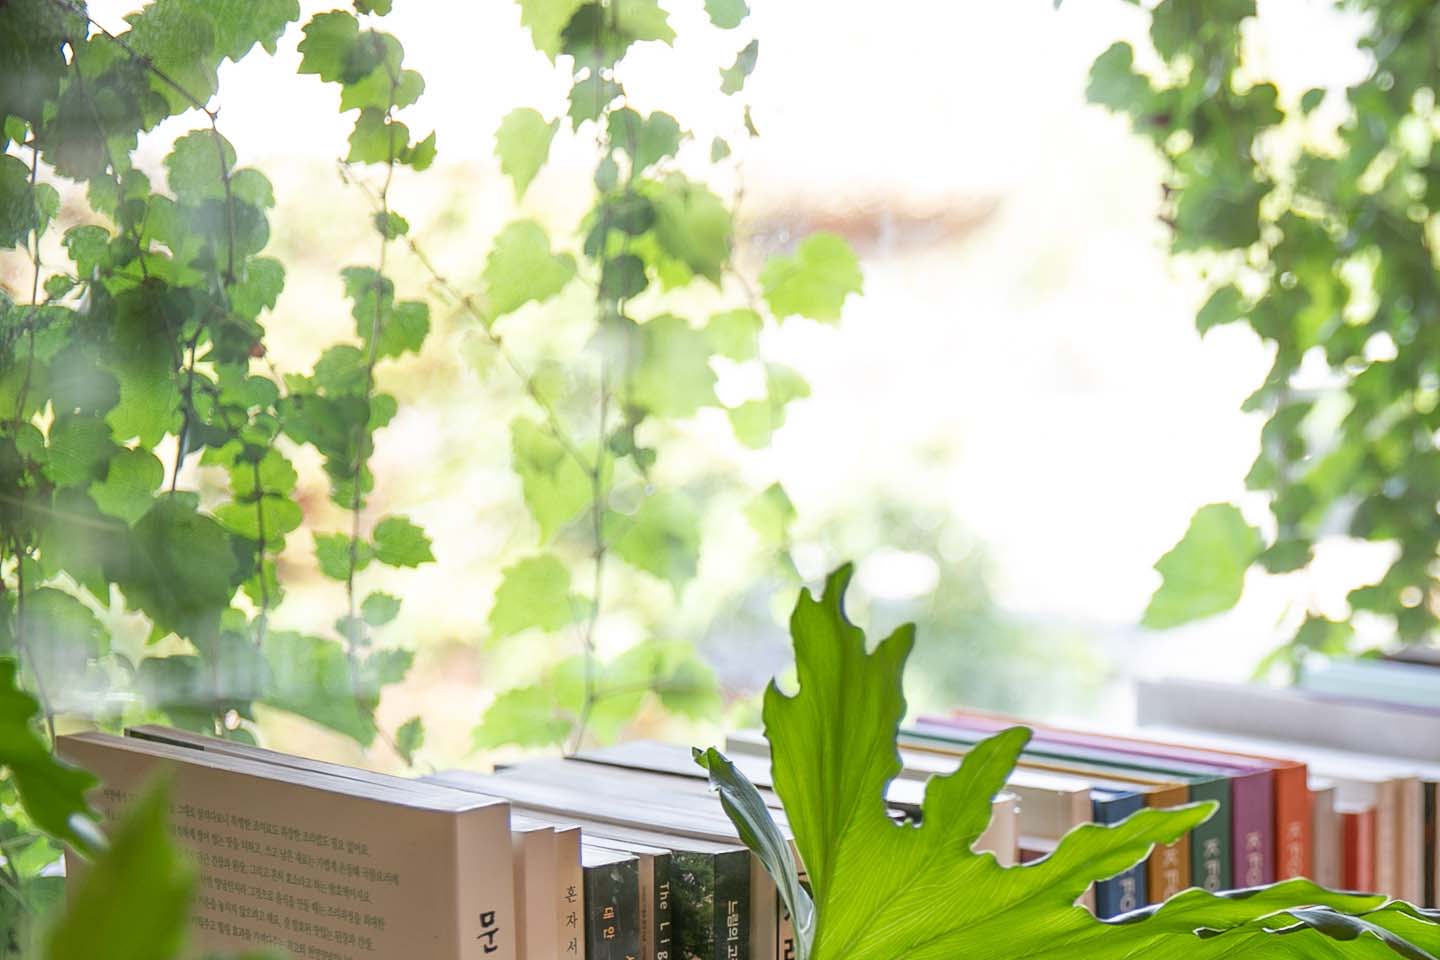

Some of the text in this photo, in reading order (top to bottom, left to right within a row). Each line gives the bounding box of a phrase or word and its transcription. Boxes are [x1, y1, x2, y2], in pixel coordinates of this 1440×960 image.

[659, 881, 671, 910] The
[602, 906, 617, 940] 대안
[726, 900, 739, 941] 느림의
